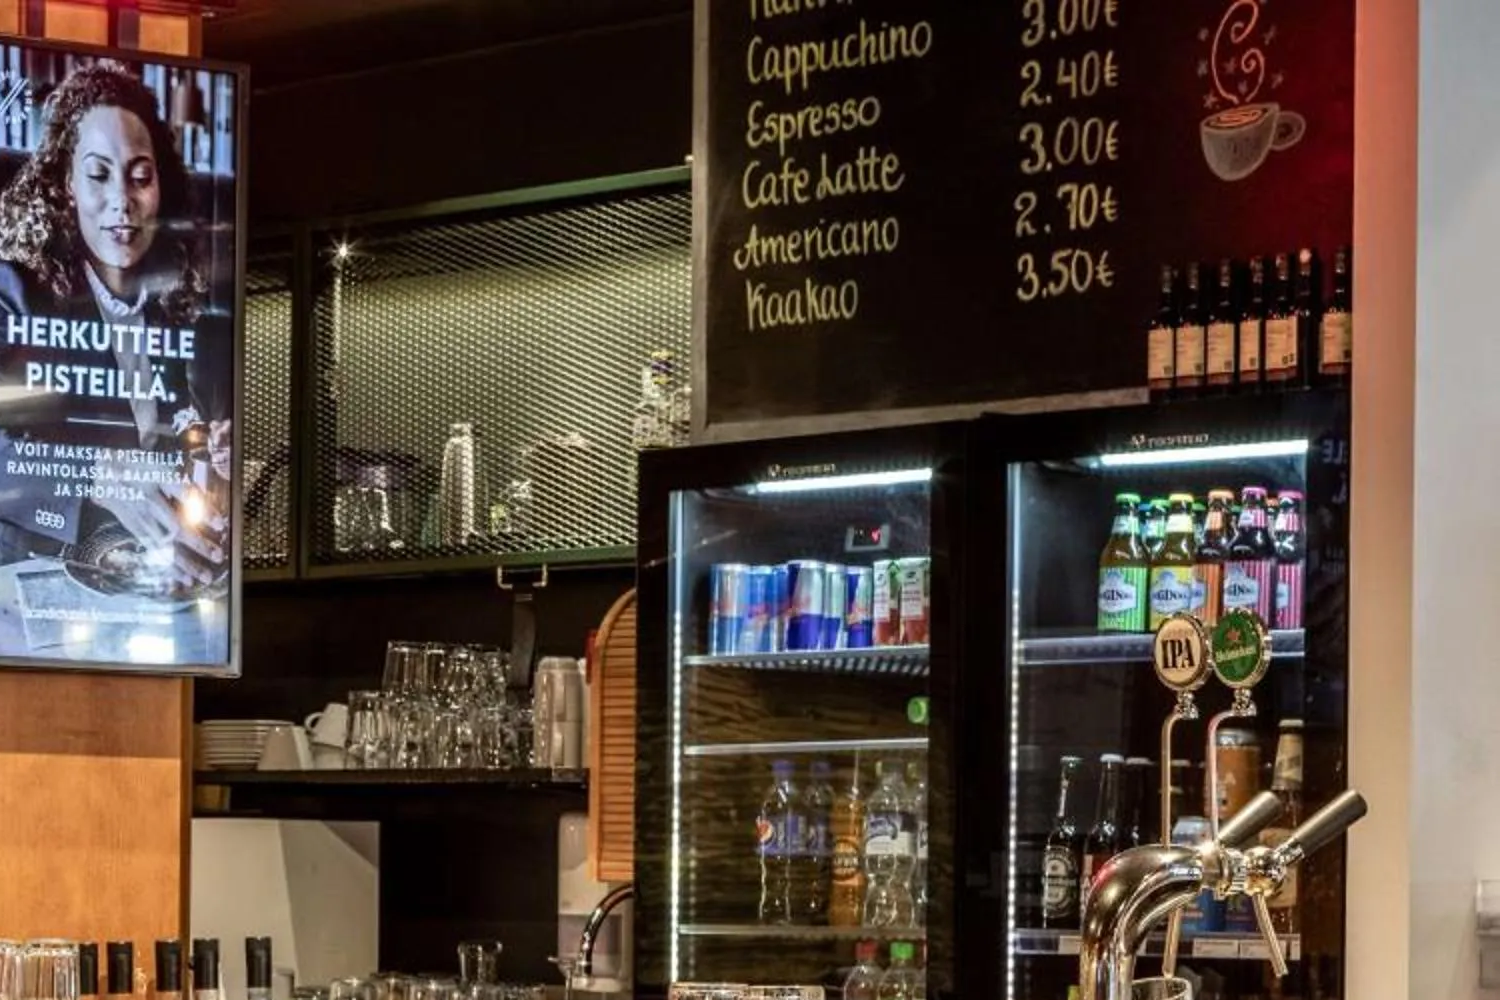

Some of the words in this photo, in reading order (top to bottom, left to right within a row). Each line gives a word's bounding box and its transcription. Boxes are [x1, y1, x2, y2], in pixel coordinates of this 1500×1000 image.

[747, 18, 932, 94] Cappuchino
[1021, 0, 1118, 47] 3.00€
[746, 96, 881, 156] Espresso
[1020, 50, 1118, 107] 2.40€
[742, 157, 811, 208] Cafe
[816, 146, 905, 200] Latte
[1020, 117, 1119, 174] 3.00€
[733, 216, 900, 270] Americano
[1013, 182, 1119, 237] 2.70€
[746, 277, 859, 332] Kaakao
[1017, 249, 1115, 301] 3.50€
[7, 314, 195, 360] HERKUTTELE
[26, 361, 177, 403] PISTEILLÄ.
[14, 441, 49, 457] VOIT
[53, 444, 113, 462] MAKSAA
[117, 449, 185, 466] PISTEILLÄ
[53, 483, 71, 498] JA
[75, 485, 146, 501] SHOPISSA
[1161, 637, 1196, 669] IPA
